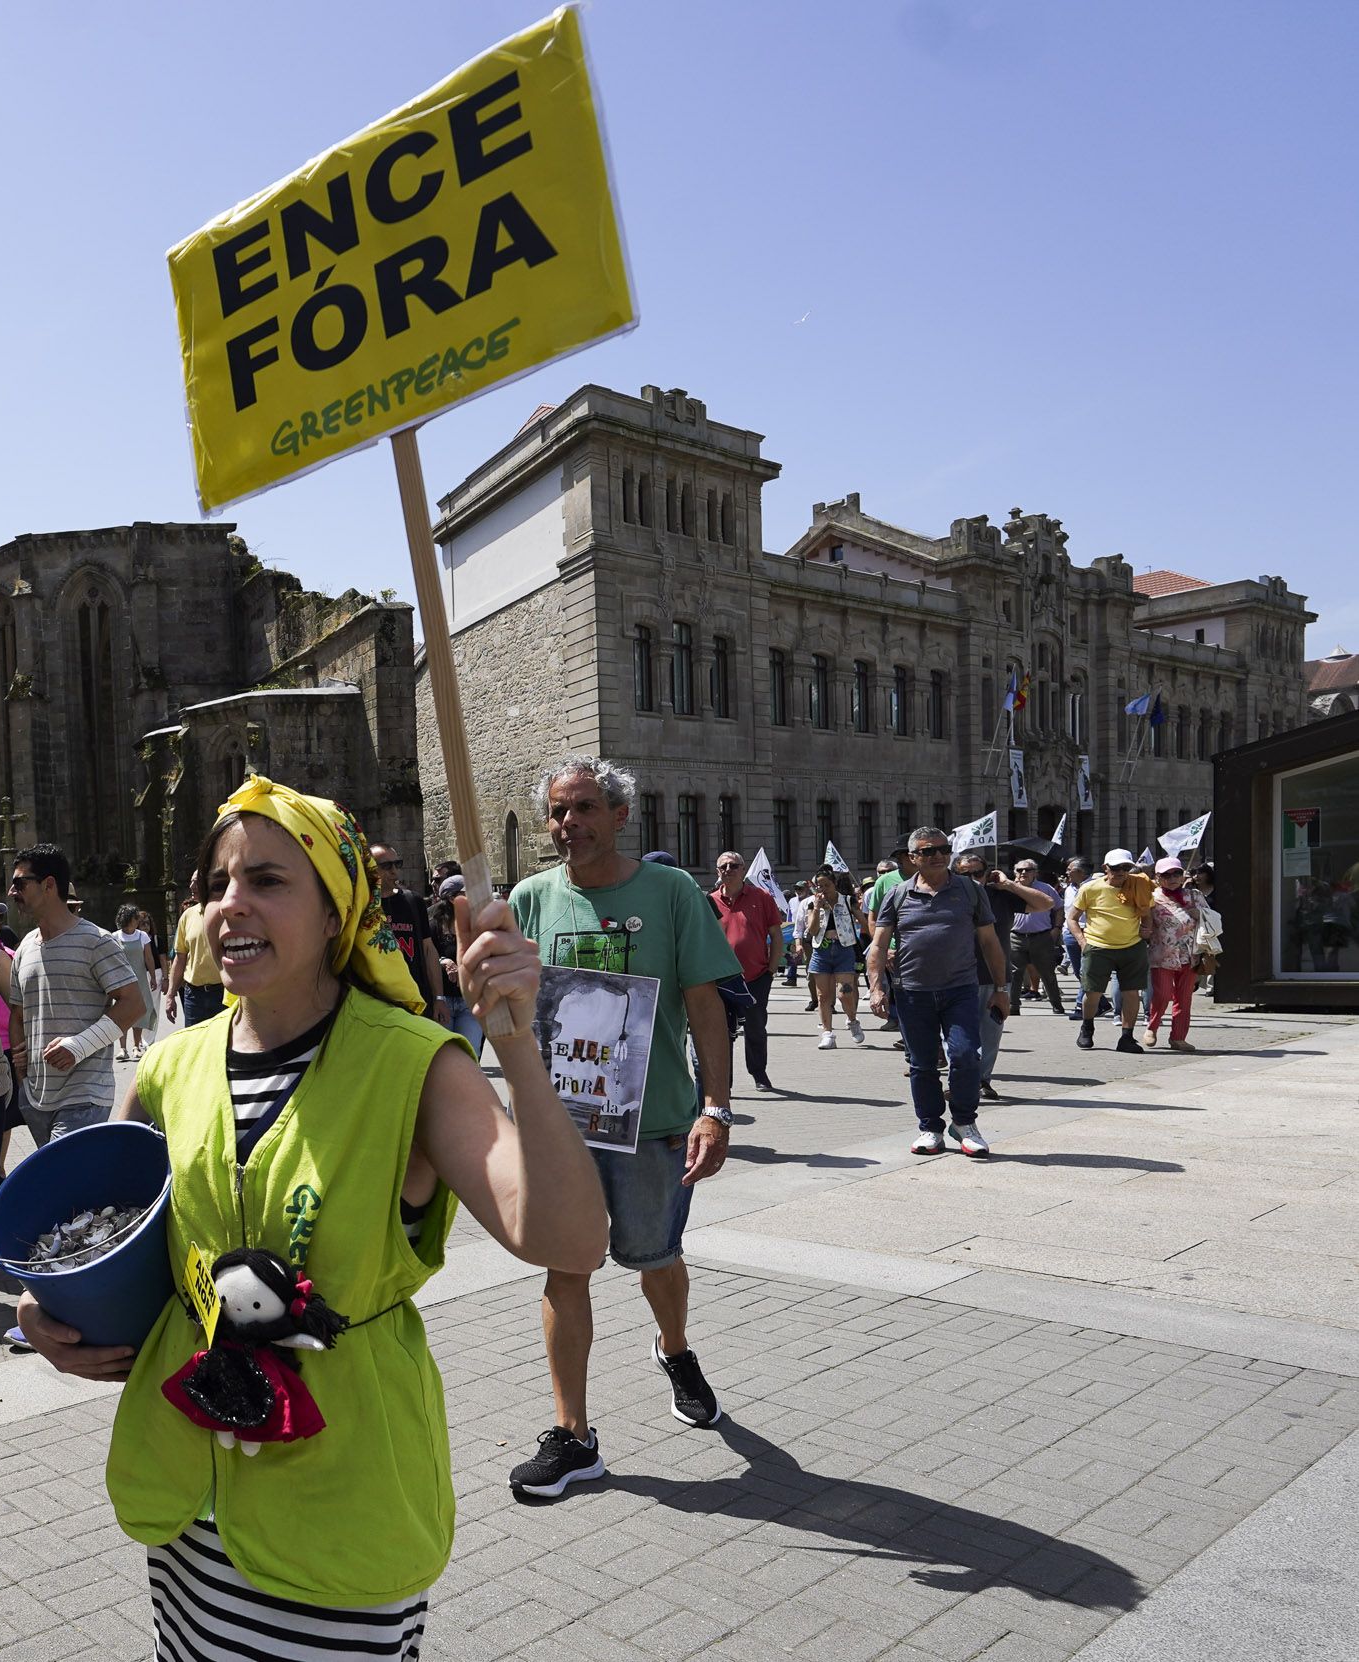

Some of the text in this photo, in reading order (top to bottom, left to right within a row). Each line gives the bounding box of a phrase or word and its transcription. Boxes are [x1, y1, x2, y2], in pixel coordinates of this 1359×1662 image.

[212, 70, 533, 319] ENCE
[226, 191, 558, 413] FÓRA
[271, 317, 520, 457] GREENPEACE
[601, 1100, 619, 1115] da
[195, 1276, 212, 1317] NON
[196, 1258, 217, 1308] ALTRI
